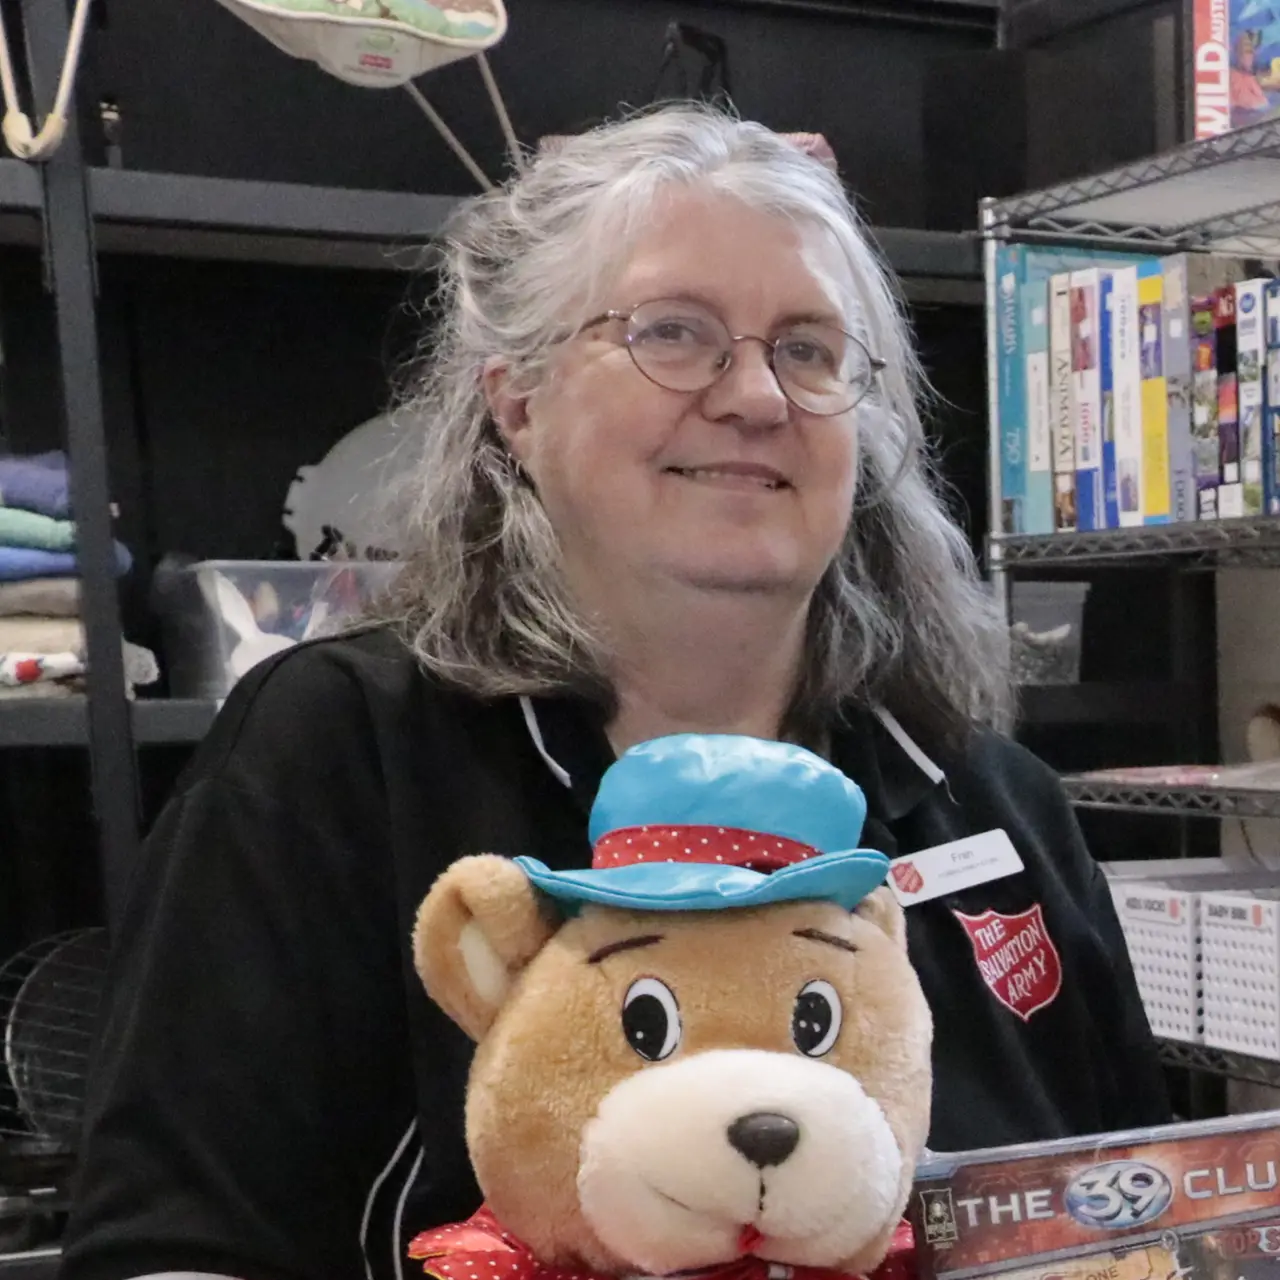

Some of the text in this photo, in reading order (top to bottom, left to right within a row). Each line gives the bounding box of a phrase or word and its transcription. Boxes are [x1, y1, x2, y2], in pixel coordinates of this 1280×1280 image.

[975, 919, 1006, 951] THE
[979, 916, 1043, 985] SALVATION
[1007, 948, 1047, 1006] ARMY
[957, 1188, 1054, 1229] THE
[1082, 1170, 1163, 1220] 39
